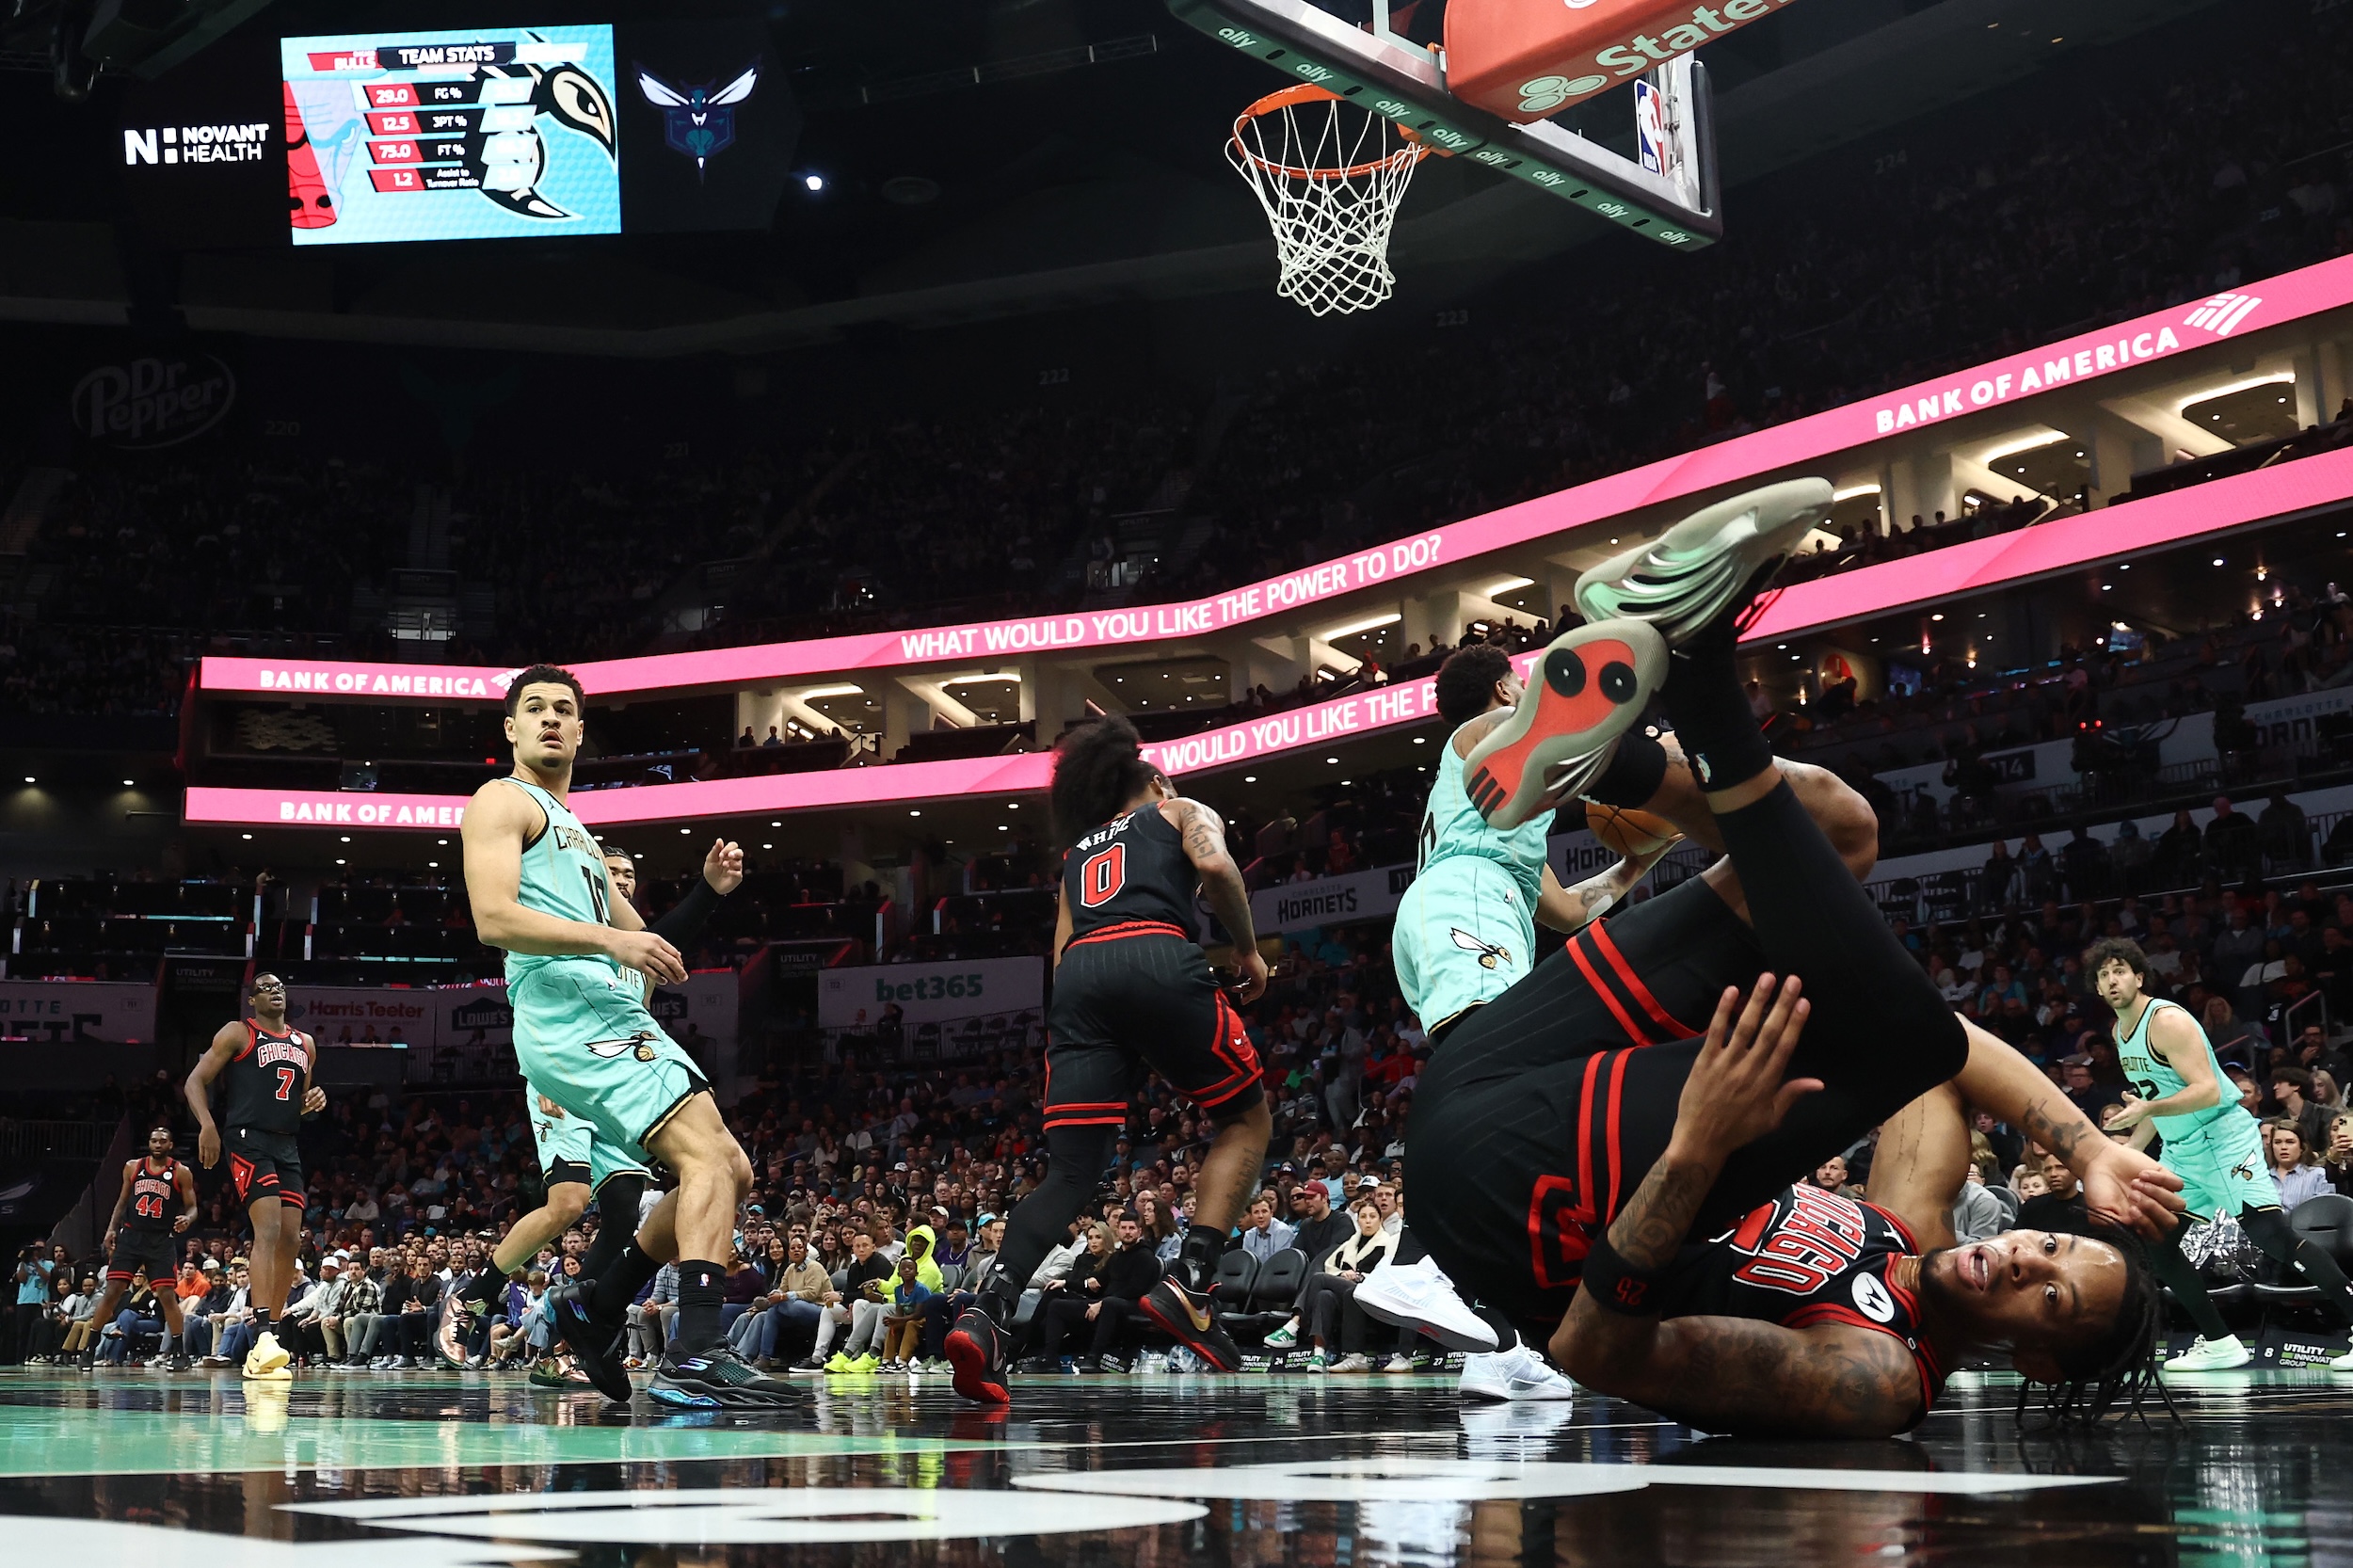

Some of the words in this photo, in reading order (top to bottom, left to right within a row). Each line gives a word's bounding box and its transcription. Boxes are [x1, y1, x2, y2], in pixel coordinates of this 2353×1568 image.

[1219, 26, 1257, 49] ally
[1595, 0, 1770, 76] State
[333, 56, 376, 71] BULLS
[398, 48, 444, 65] TEAM
[446, 45, 495, 63] STATS
[1296, 61, 1332, 84] ally
[376, 88, 408, 104] 29.0
[434, 88, 448, 100] FG
[449, 87, 463, 99] %
[1374, 96, 1410, 119] ally
[381, 116, 410, 130] 12.5
[432, 116, 454, 128] 3PT
[455, 115, 468, 127] %
[182, 123, 270, 144] NOVANT
[1433, 127, 1467, 150] ally
[183, 143, 263, 163] HEALTH
[378, 144, 411, 158] 75.0
[437, 144, 451, 156] FT
[452, 143, 465, 155] %
[1475, 149, 1510, 168] ally
[1643, 152, 1658, 172] NBA
[393, 172, 413, 186] 1.2
[1532, 167, 1565, 188] ally
[1596, 200, 1627, 220] ally
[1659, 229, 1690, 247] ally
[1435, 310, 1469, 327] 223
[131, 358, 187, 399] Dr
[1876, 388, 1963, 433] BANK
[1970, 374, 2012, 406] OF
[2020, 327, 2180, 392] AMERICA
[75, 365, 224, 439] Pepper
[264, 420, 301, 437] 220
[901, 629, 978, 659] WHAT
[984, 618, 1085, 651] WOULD
[1092, 612, 1148, 640] YOU
[1158, 602, 1212, 633] LIKE
[1217, 588, 1260, 623] THE
[1267, 564, 1347, 610] POWER
[1353, 554, 1386, 583] TO
[1393, 535, 1442, 573] DO?
[260, 670, 328, 690] BANK
[335, 672, 368, 692] OF
[372, 674, 487, 696] AMERICA
[1160, 730, 1246, 772] WOULD
[1251, 713, 1300, 749] YOU
[1306, 701, 1357, 737] LIKE
[1365, 687, 1414, 723] THE
[280, 801, 352, 822] BANK
[357, 804, 392, 823] OF
[1076, 811, 1136, 851] WHITE
[1080, 842, 1126, 908] 0
[1398, 871, 1416, 889] 11
[1278, 888, 1357, 923] HORNETS
[780, 953, 817, 963] UTILITY
[176, 968, 215, 977] UTILITY
[875, 974, 984, 1002] bet365
[309, 1000, 364, 1017] Harris
[366, 1000, 424, 1018] Teeter
[457, 1008, 508, 1026] LOWE'S
[257, 1042, 309, 1074] CHICAGO
[276, 1066, 296, 1100] 7
[135, 1178, 171, 1200] CHICAGO
[136, 1194, 163, 1218] 44
[1615, 1275, 1649, 1306] 25
[2264, 1347, 2275, 1357] 8
[2283, 1342, 2325, 1356] UTILITY
[1433, 1357, 1443, 1366] 27
[2279, 1359, 2306, 1368] GROUP
